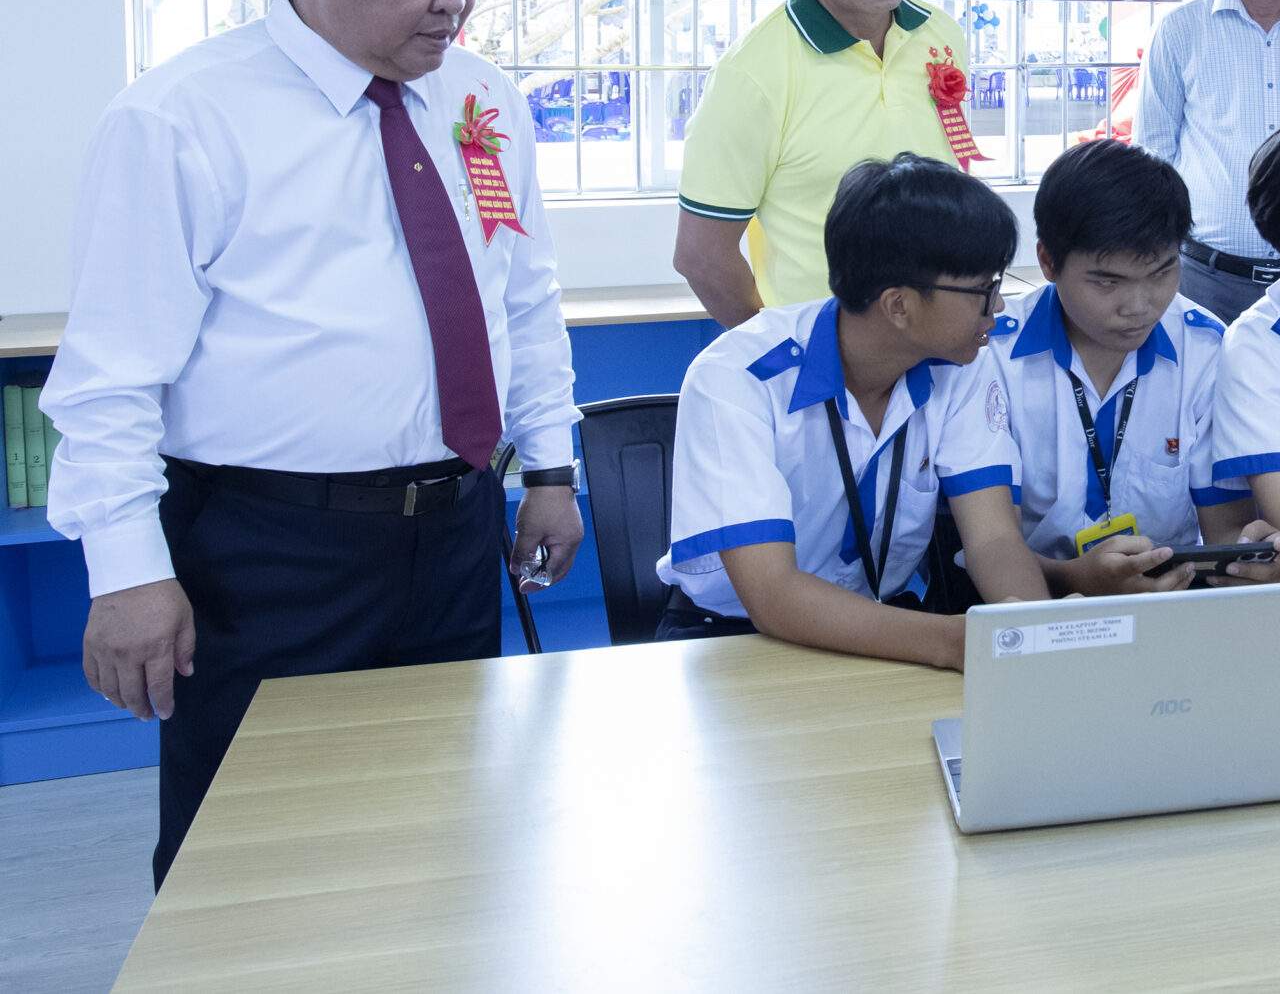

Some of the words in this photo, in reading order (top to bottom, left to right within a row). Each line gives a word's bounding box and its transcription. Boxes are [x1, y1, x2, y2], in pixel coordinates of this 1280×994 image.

[1074, 387, 1084, 407] Dior
[1086, 428, 1096, 447] Dior
[33, 455, 41, 463] 2
[1150, 698, 1193, 716] AOC
